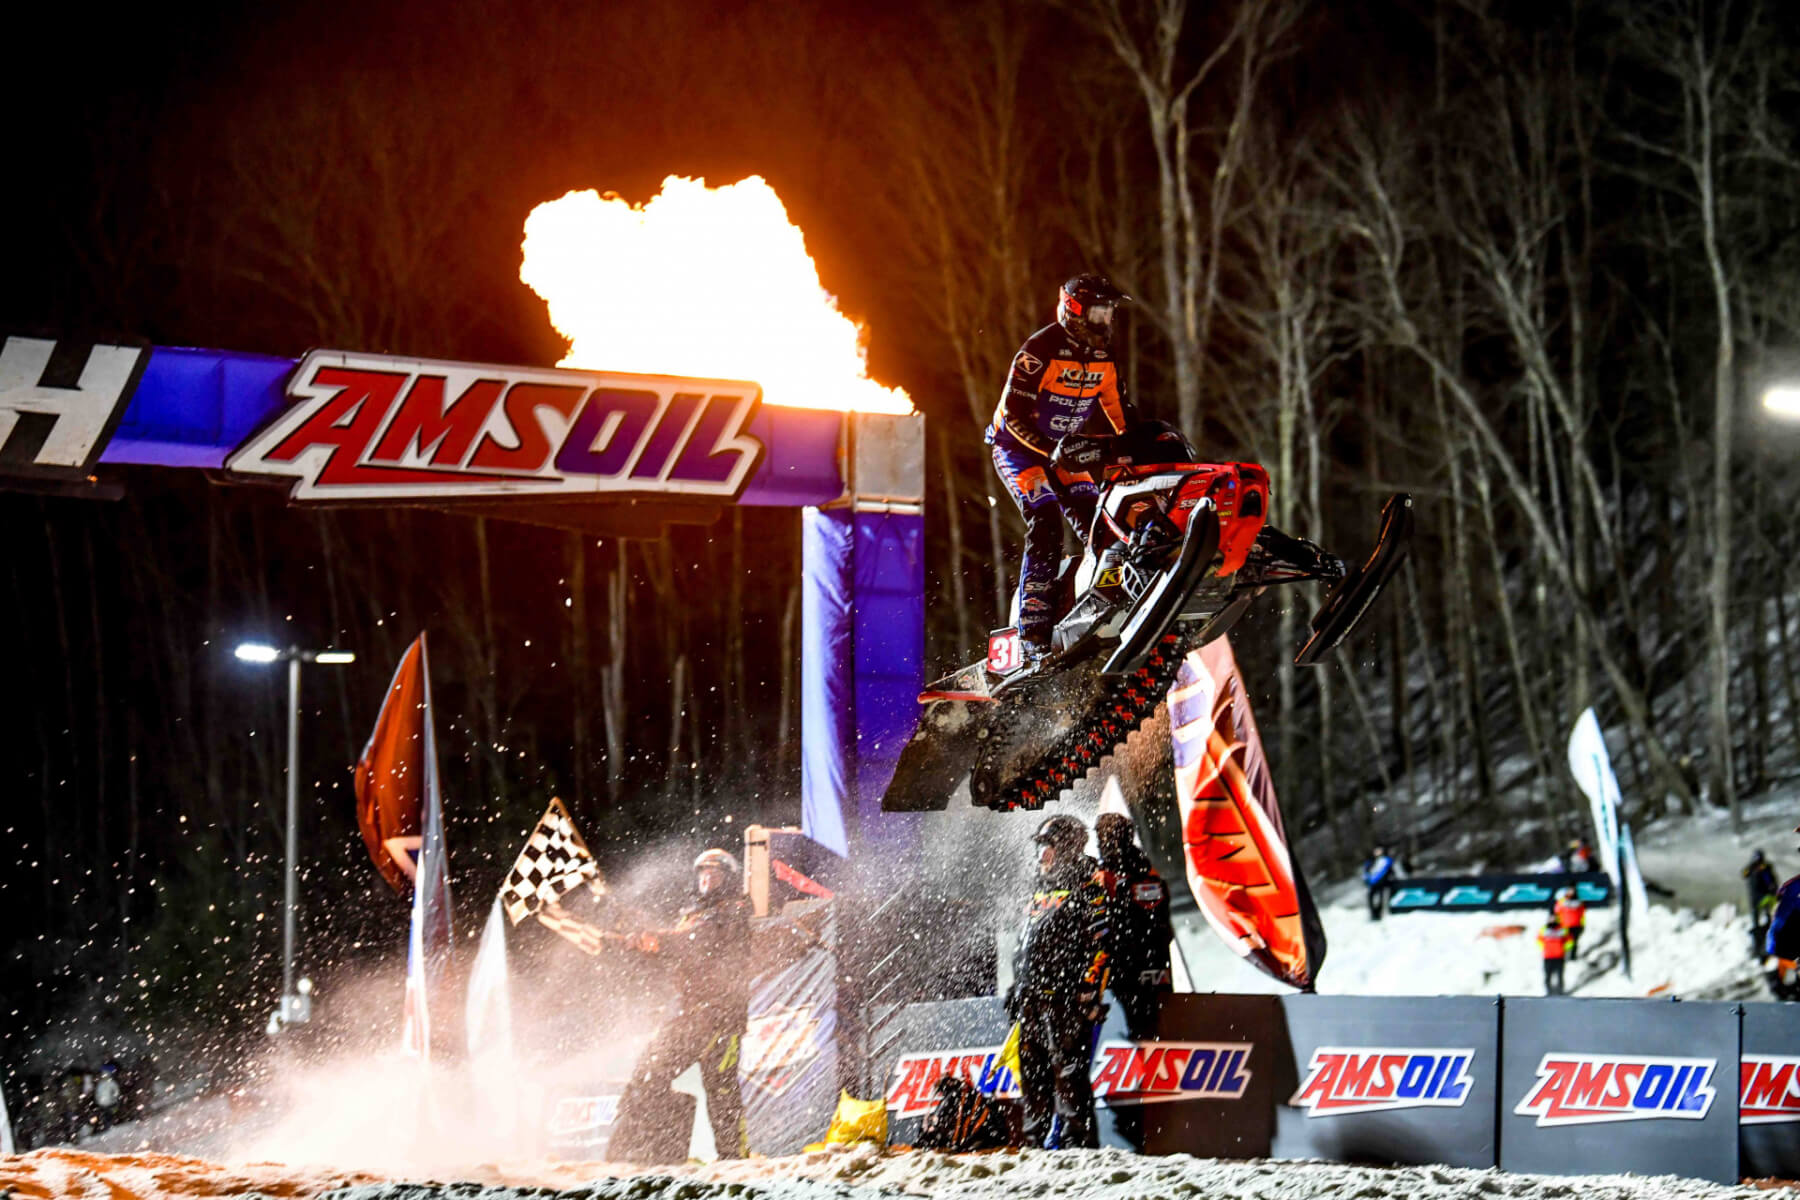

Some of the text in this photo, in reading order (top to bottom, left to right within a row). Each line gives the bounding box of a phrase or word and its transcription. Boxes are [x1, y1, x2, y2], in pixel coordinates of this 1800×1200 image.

[262, 366, 748, 486] AMSOIL
[1098, 569, 1120, 586] K
[1092, 1047, 1249, 1100] AMSOIL
[1300, 1055, 1468, 1112] AMSOIL
[1529, 1062, 1710, 1118] AMSOIL
